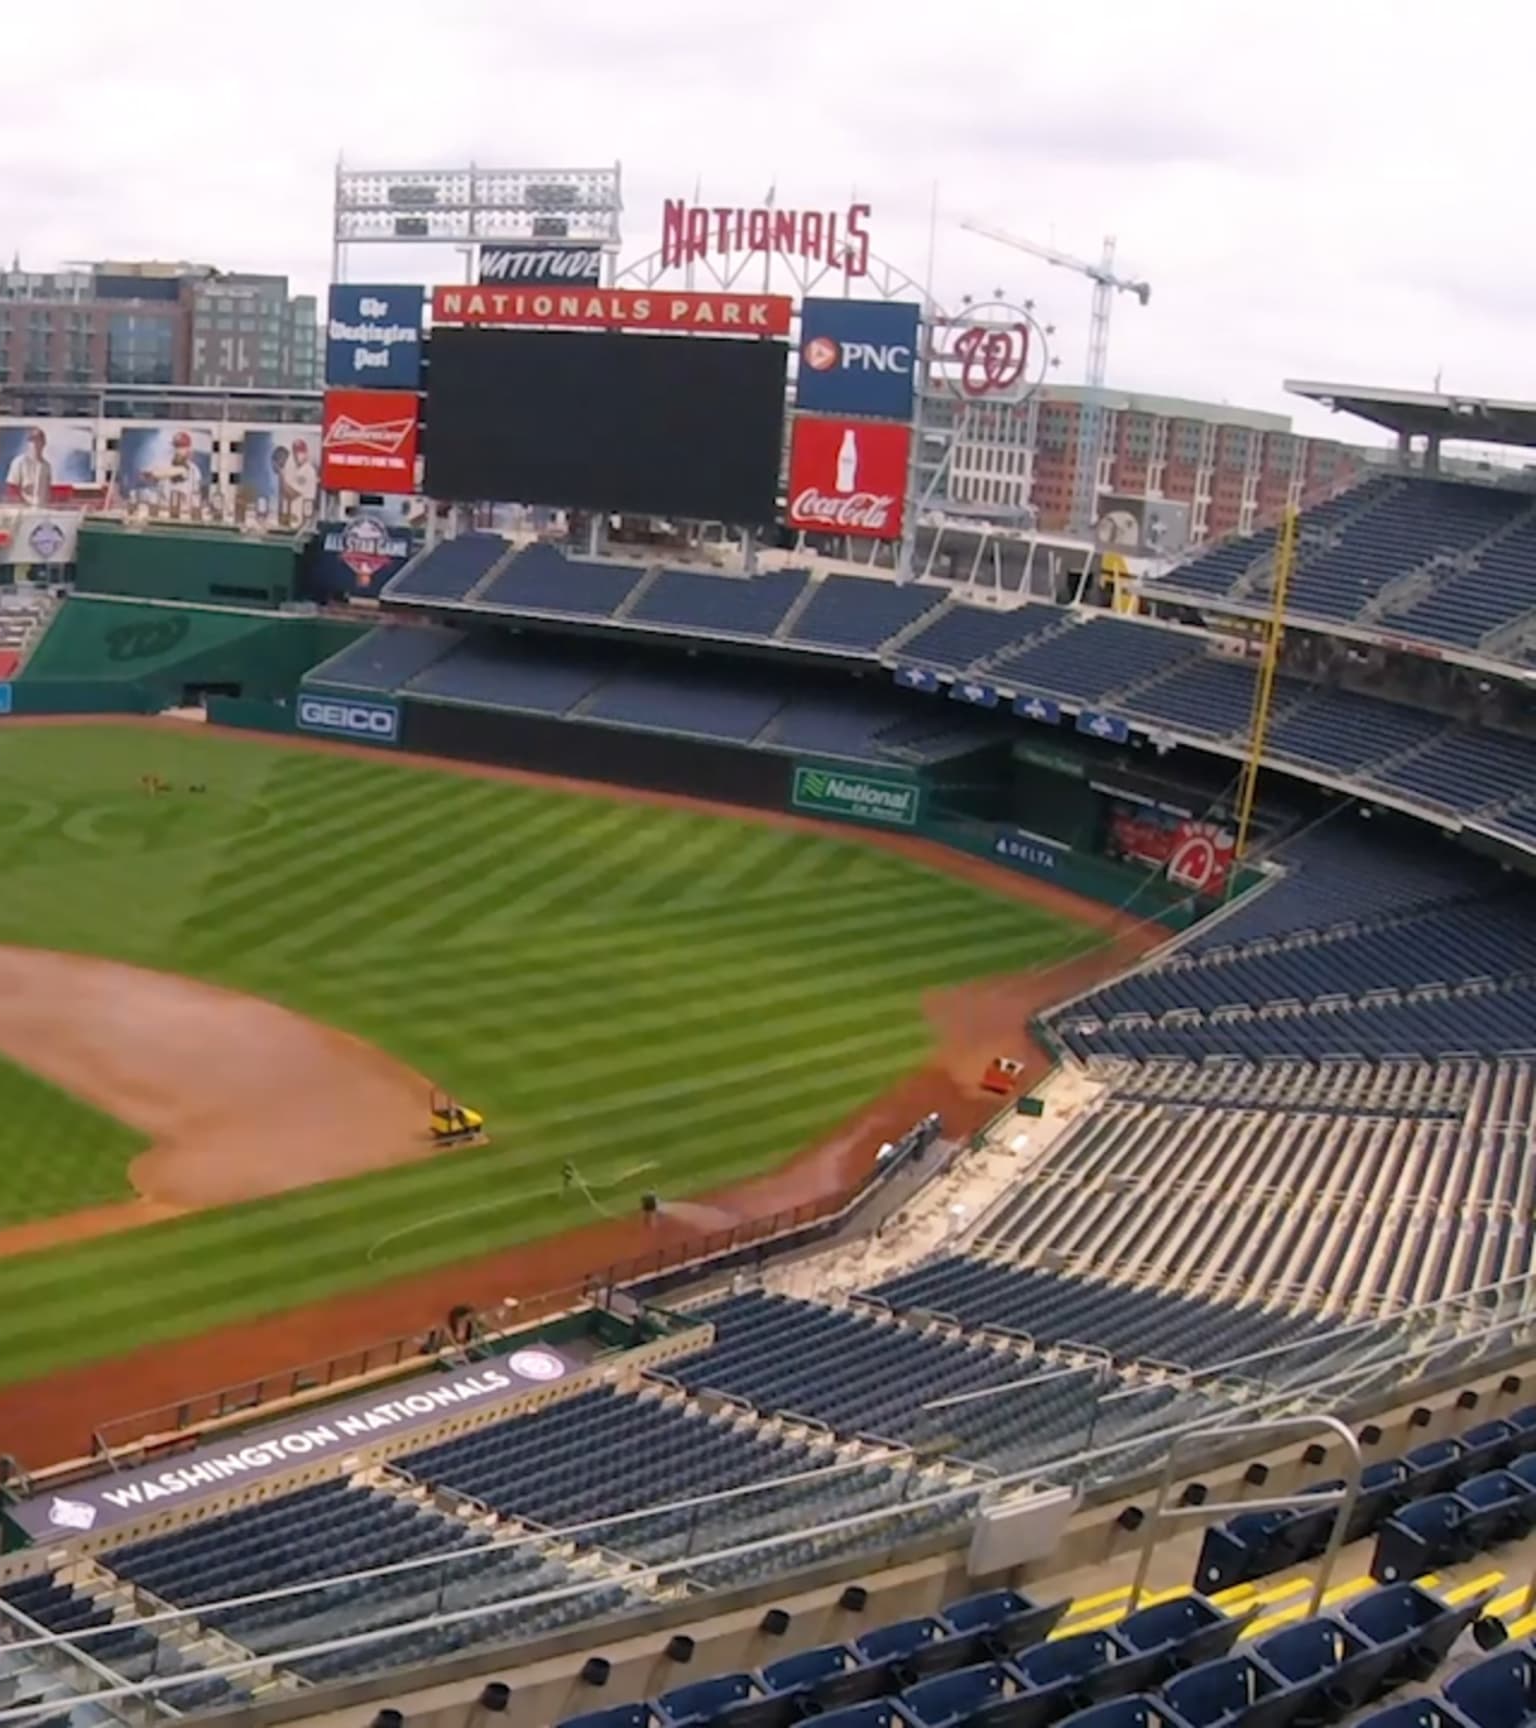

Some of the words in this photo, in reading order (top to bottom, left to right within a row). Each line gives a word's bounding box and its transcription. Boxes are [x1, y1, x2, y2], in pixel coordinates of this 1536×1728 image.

[662, 199, 870, 277] NATIONALS
[481, 250, 600, 279] NATITUDE
[359, 297, 389, 318] The
[443, 293, 652, 321] NATIONALS
[671, 299, 769, 326] PARK
[330, 319, 417, 346] Washington
[353, 347, 389, 371] Post
[840, 341, 910, 374] PNC
[791, 487, 895, 528] Coca-Cola
[301, 701, 394, 733] GEICO
[826, 778, 911, 810] National
[1010, 842, 1055, 869] DELTA
[101, 1424, 340, 1510] WASHINGTON
[333, 1370, 512, 1445] NATIONALS
